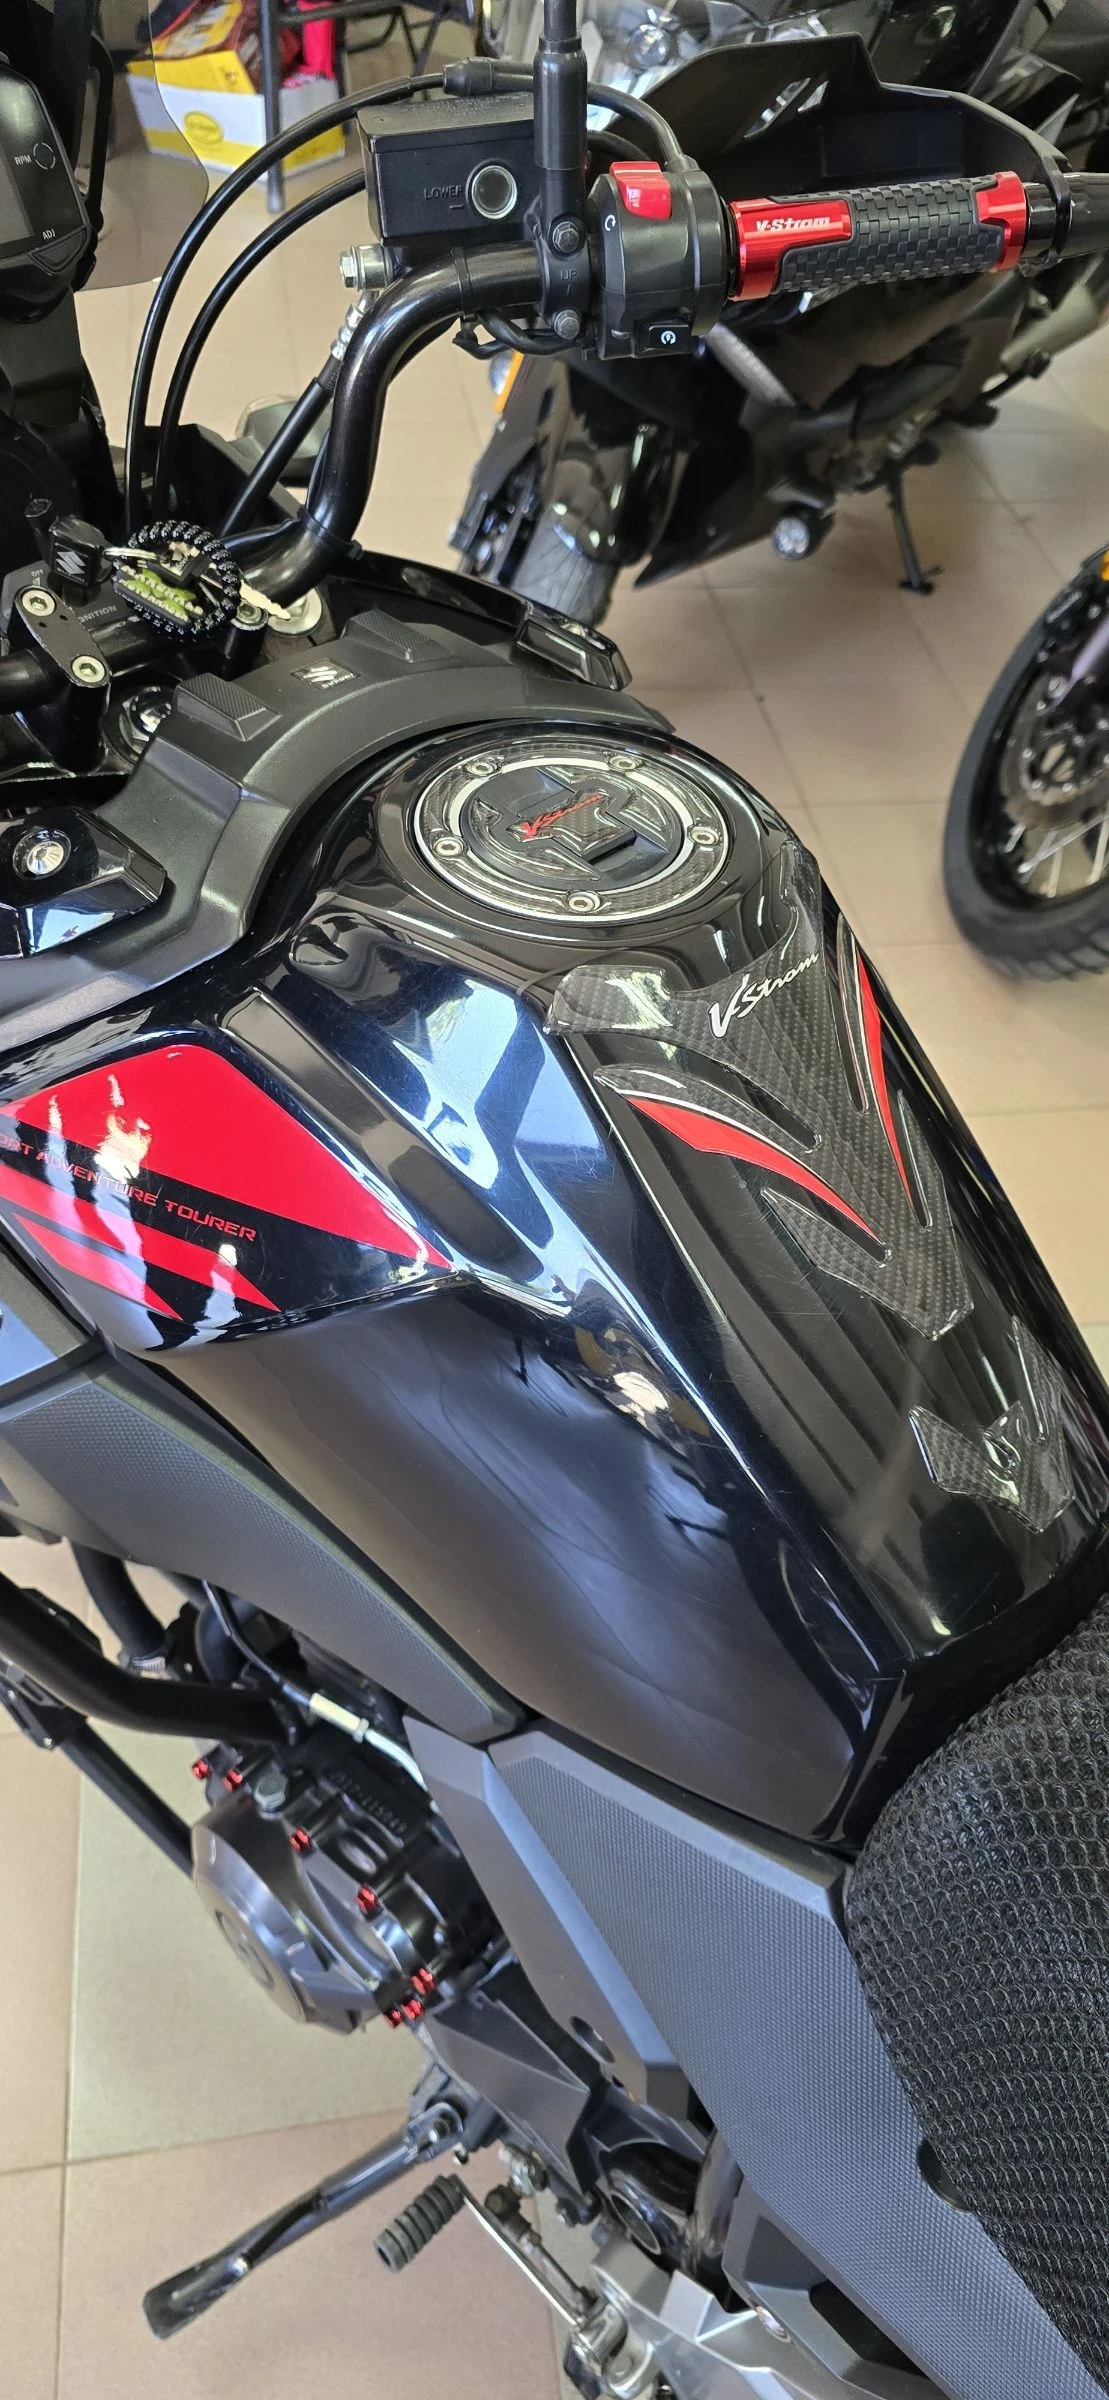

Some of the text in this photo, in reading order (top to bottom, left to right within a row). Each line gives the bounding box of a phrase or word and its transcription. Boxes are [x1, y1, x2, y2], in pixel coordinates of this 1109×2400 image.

[14, 154, 32, 166] RPM
[423, 184, 463, 200] LOWER
[756, 216, 831, 233] V-Strom
[42, 228, 56, 240] ADJ
[35, 1150, 157, 1207] ADVENTURE
[164, 1199, 257, 1242] TOURER
